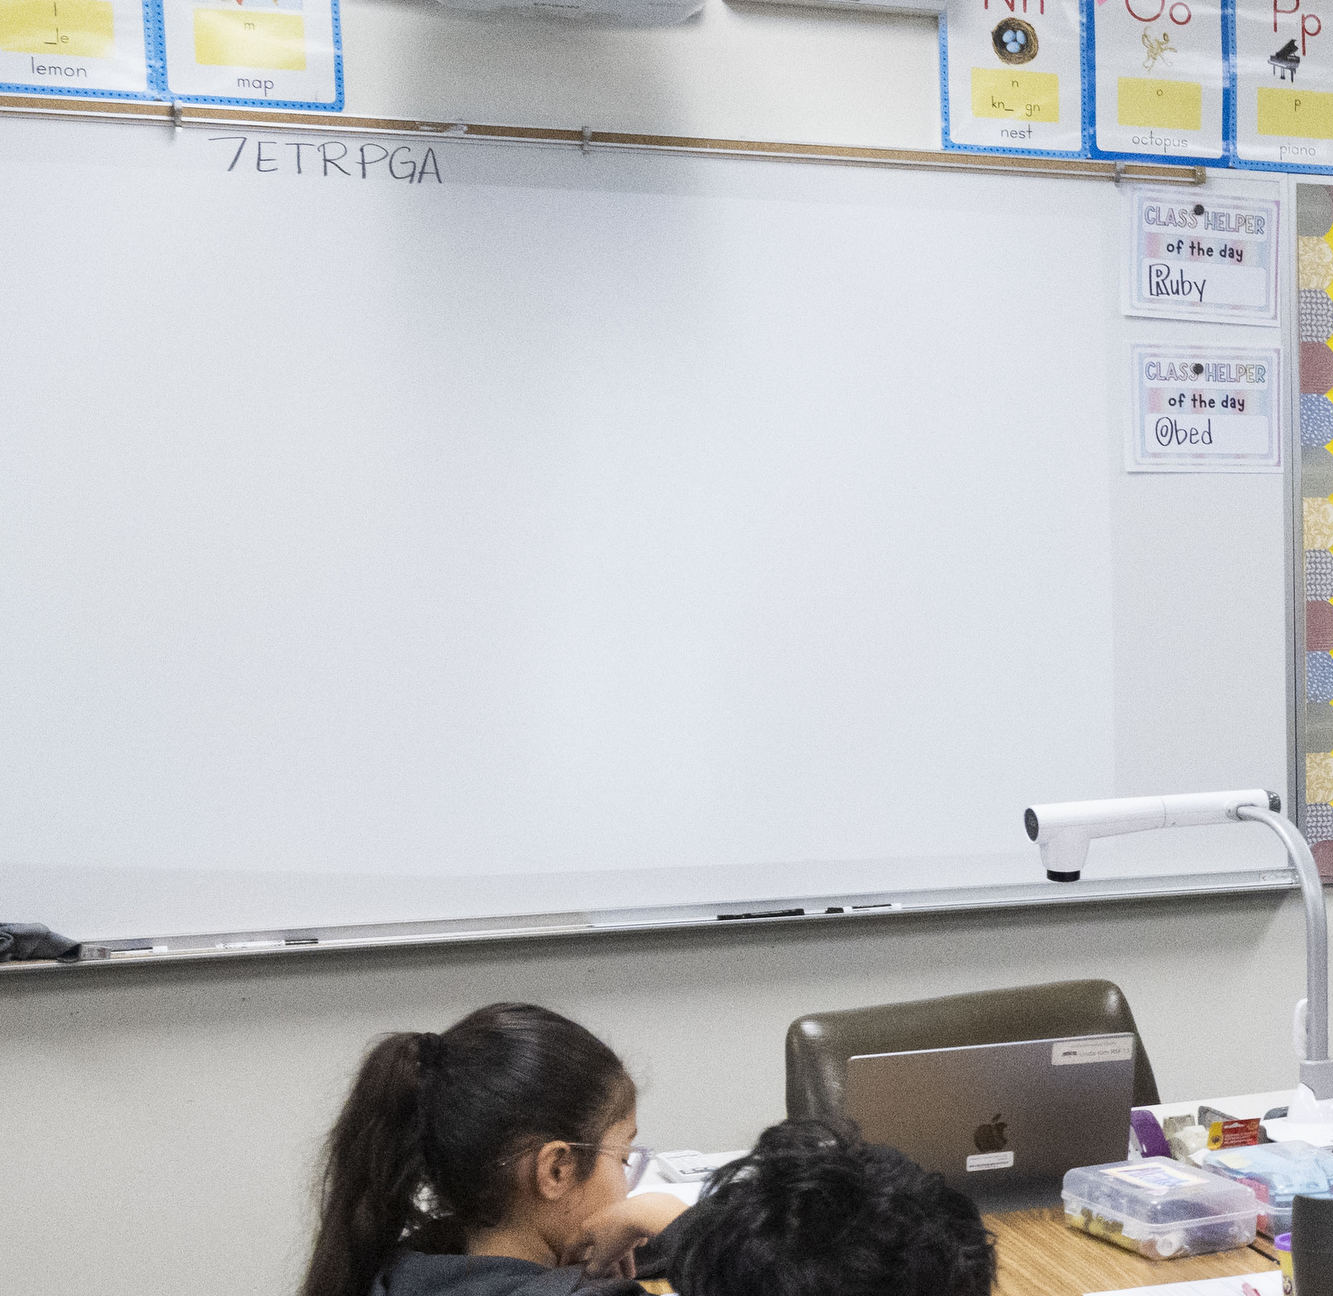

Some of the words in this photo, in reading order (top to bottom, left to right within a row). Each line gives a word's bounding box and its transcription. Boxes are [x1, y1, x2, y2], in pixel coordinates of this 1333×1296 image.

[1273, 0, 1321, 56] Pp
[30, 56, 88, 79] lemon
[237, 76, 275, 97] map
[1000, 124, 1033, 140] nest
[1132, 131, 1189, 153] octopus
[1279, 143, 1317, 160] piano
[1144, 205, 1199, 229] CLASS
[1203, 210, 1266, 235] HELPER
[1166, 240, 1184, 255] of
[1189, 241, 1214, 257] the
[1219, 244, 1244, 263] day
[1149, 263, 1206, 302] Ruby
[1144, 361, 1199, 381] CLASS
[1204, 362, 1267, 383] HELPER
[1168, 393, 1186, 408] of
[1191, 393, 1216, 409] the
[1221, 394, 1245, 412] day
[1155, 416, 1213, 447] Obed
